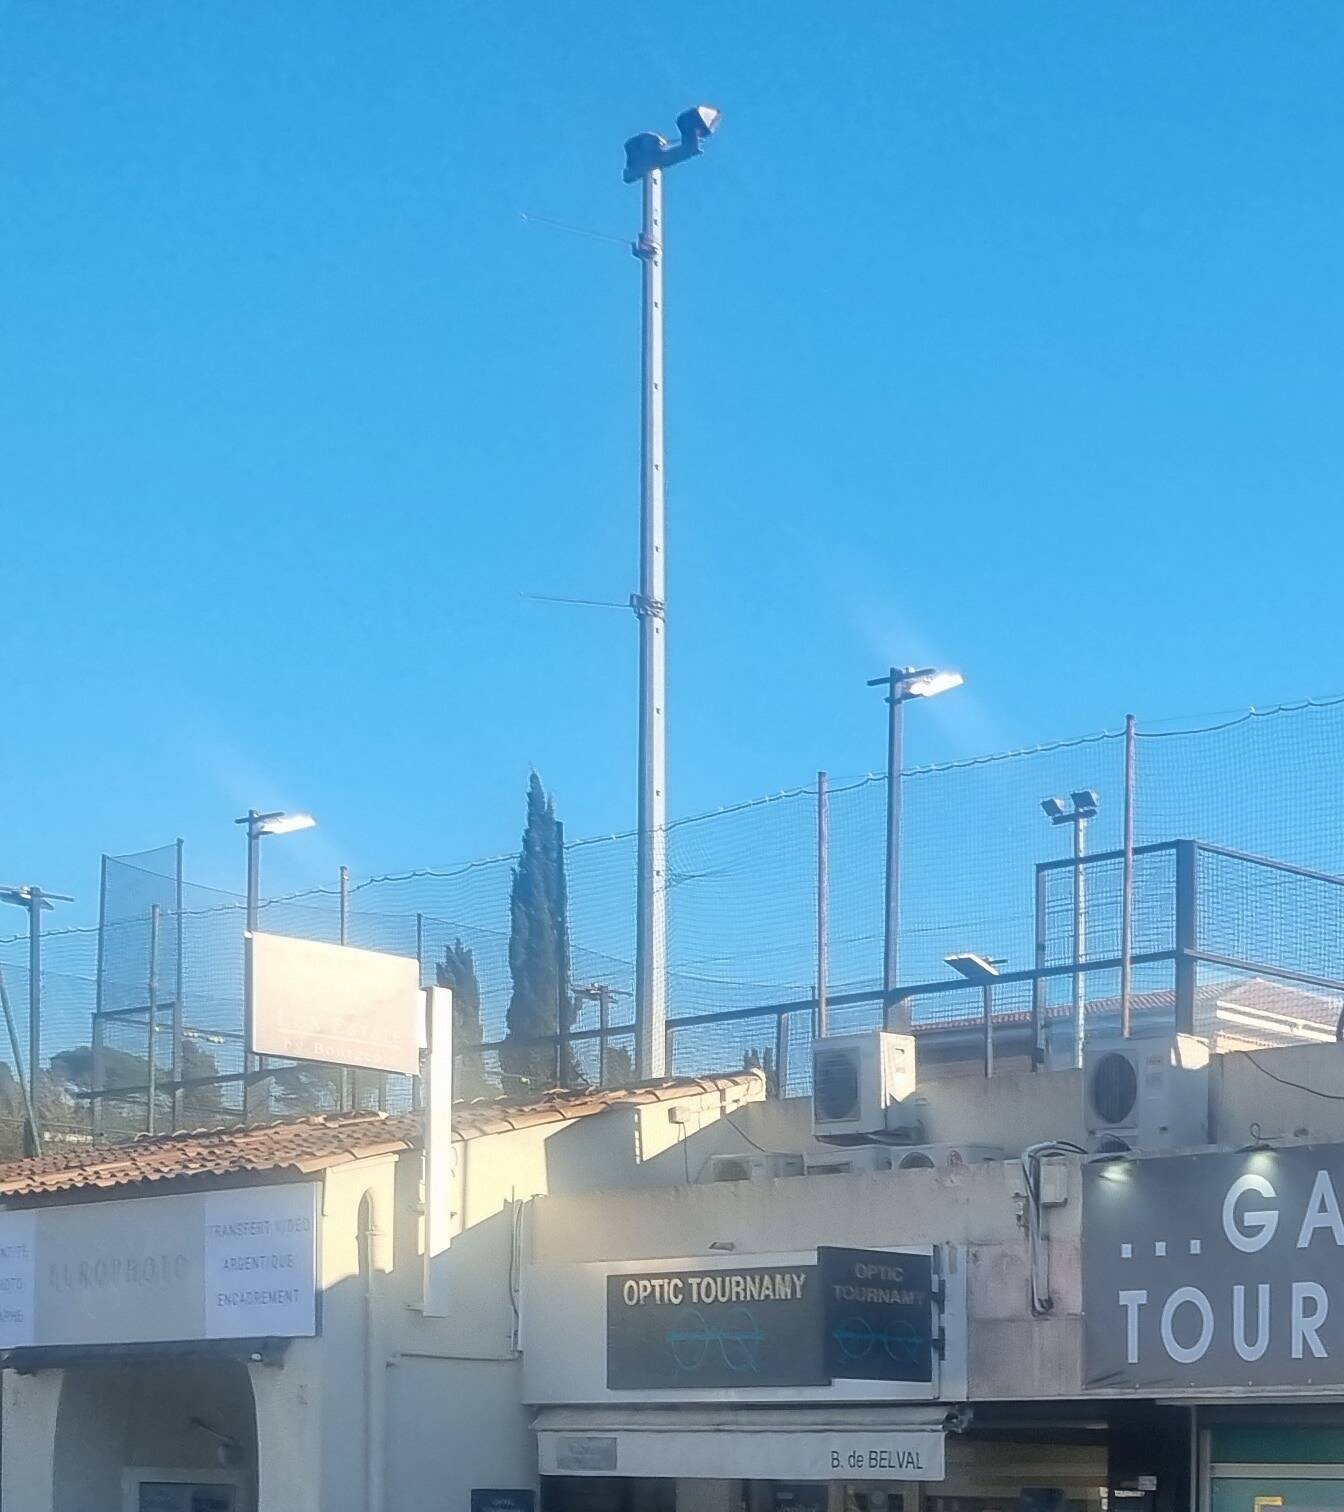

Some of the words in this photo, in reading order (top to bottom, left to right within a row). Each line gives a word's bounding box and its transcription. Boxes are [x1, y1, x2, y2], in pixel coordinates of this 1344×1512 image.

[223, 1254, 295, 1271] ARGENTIQUE
[854, 1263, 904, 1282] OPTIC
[217, 1289, 300, 1307] ENCADREMENT
[623, 1279, 684, 1306] OPTIC
[688, 1272, 806, 1304] TOURNAMY
[834, 1285, 926, 1306] TOURNAMY
[831, 1450, 844, 1468] B.
[848, 1450, 864, 1468] de
[868, 1450, 924, 1469] BELVAL
